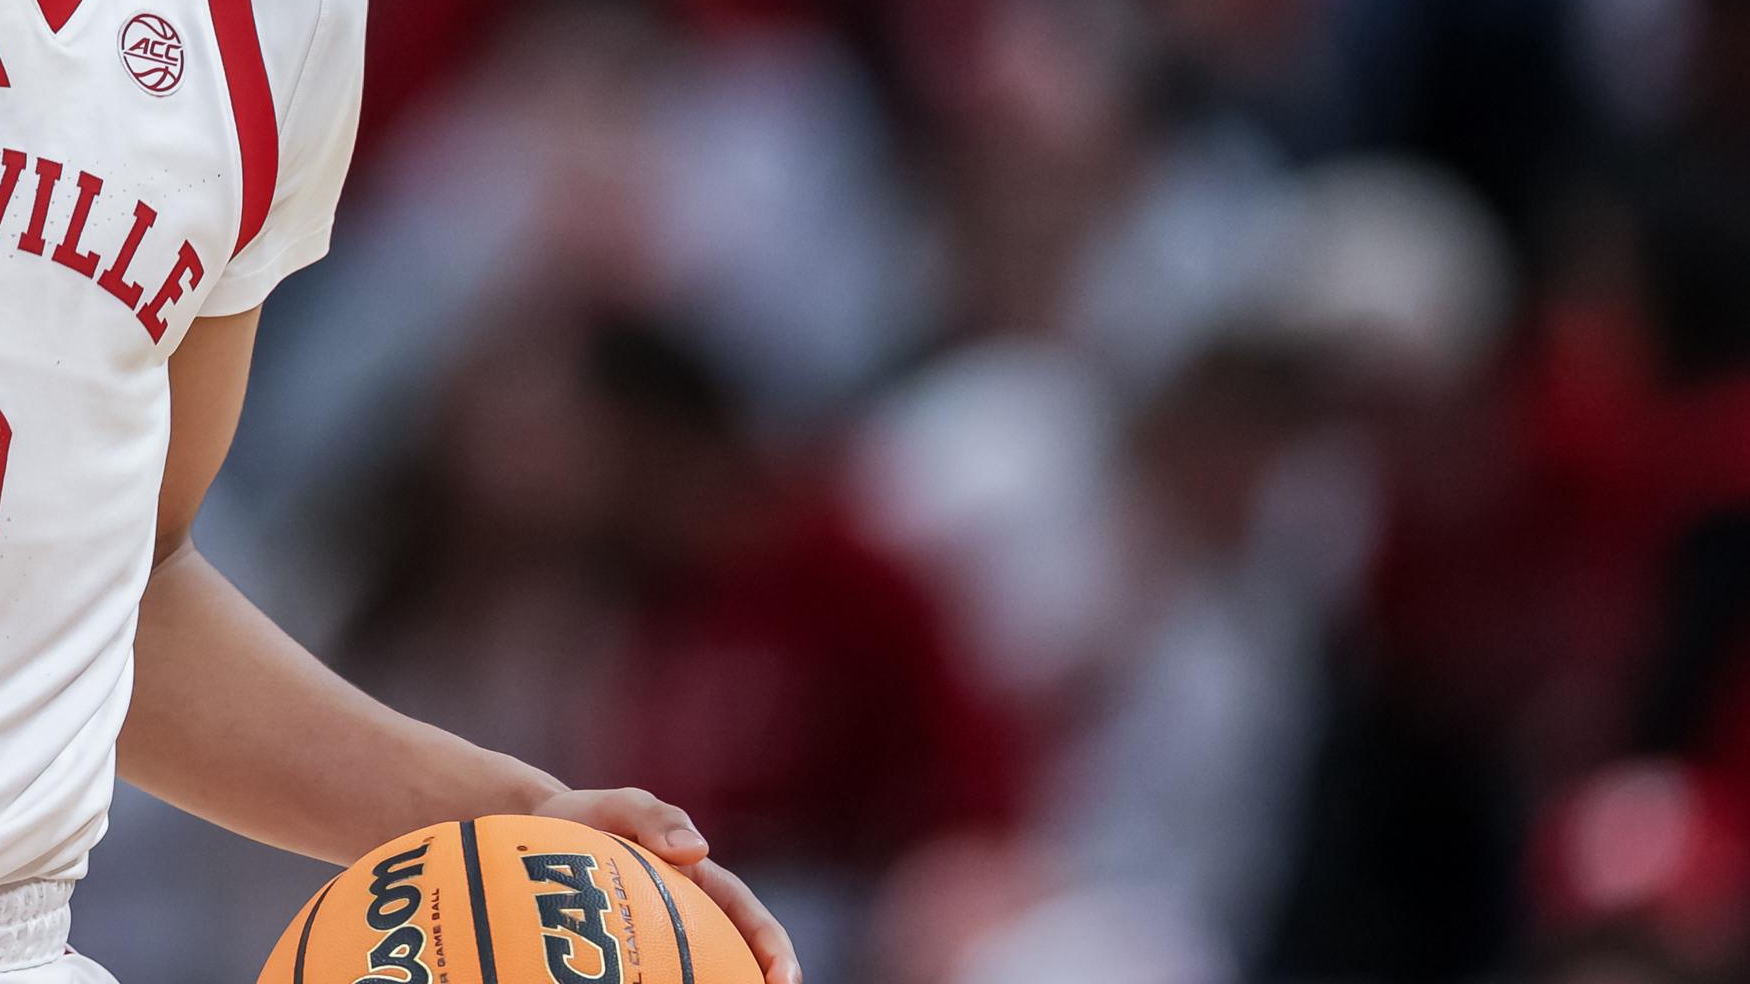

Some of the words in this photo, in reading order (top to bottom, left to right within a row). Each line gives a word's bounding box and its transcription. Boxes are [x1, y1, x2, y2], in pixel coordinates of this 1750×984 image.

[128, 37, 182, 62] ACC
[605, 857, 628, 901] BALL
[431, 888, 441, 921] BALL
[432, 925, 447, 967] GAME
[618, 903, 640, 966] GAME
